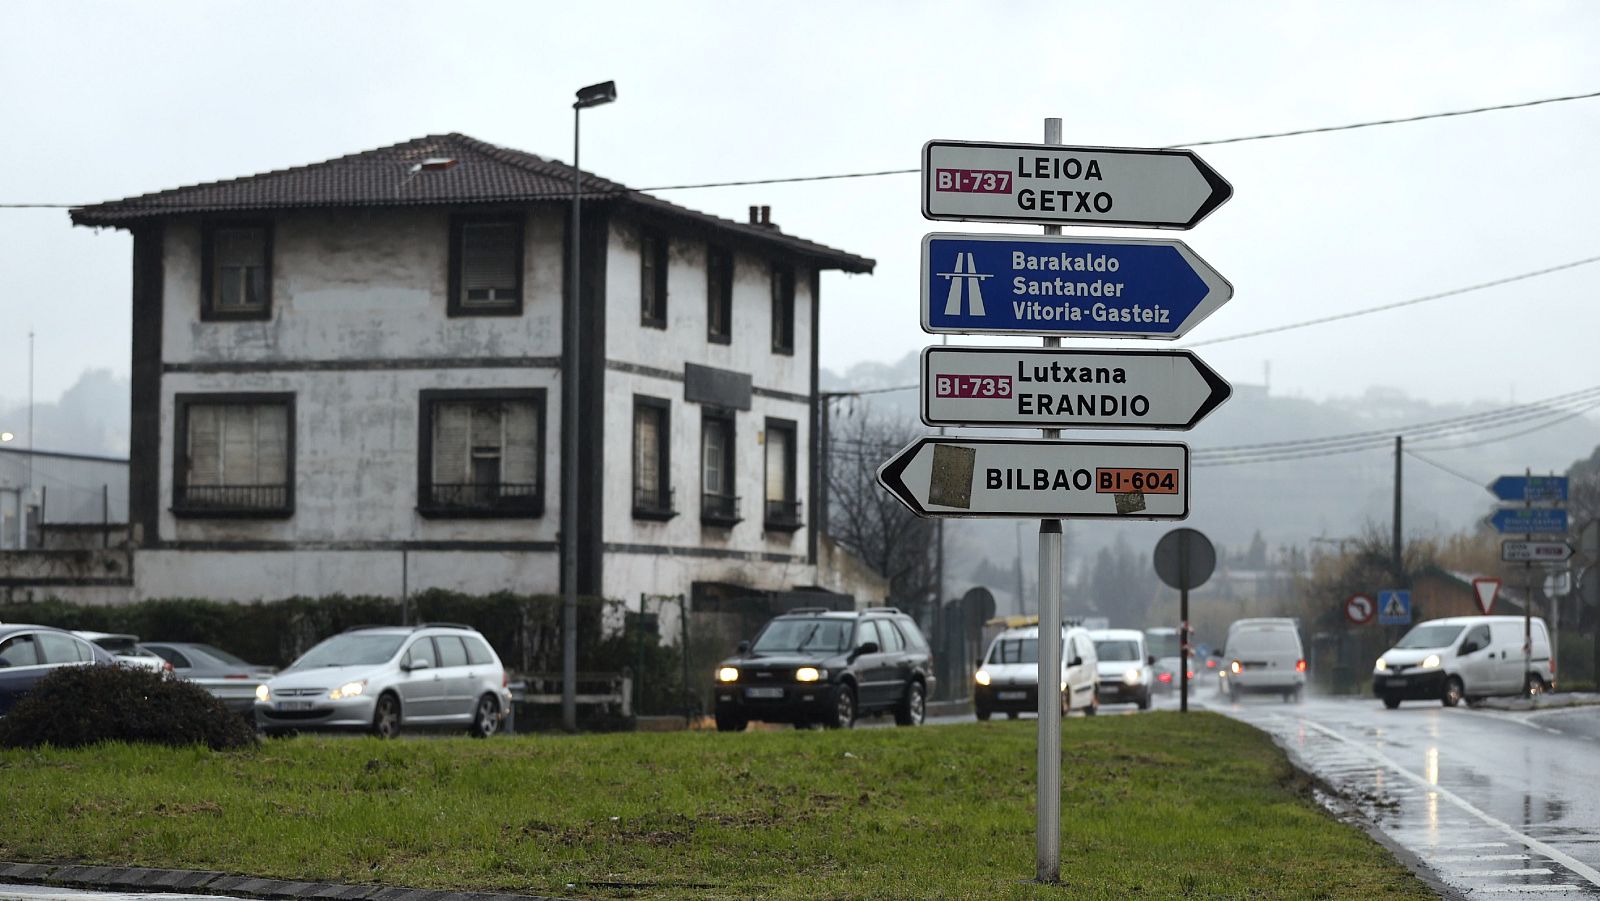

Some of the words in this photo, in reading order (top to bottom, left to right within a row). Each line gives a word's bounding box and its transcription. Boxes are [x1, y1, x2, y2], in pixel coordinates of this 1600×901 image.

[1019, 157, 1102, 180] LEIOA
[938, 172, 1010, 190] BI-737
[1018, 189, 1112, 213] GETXO
[1013, 252, 1119, 272] Barakaldo
[1013, 277, 1124, 296] Santander
[1013, 302, 1169, 322] Vitoria-Gasteiz
[1019, 361, 1126, 383] Lutxana
[938, 378, 1010, 396] BI-735
[1019, 394, 1149, 416] ERANDIO
[987, 469, 1091, 490] BILBAO
[1101, 472, 1174, 490] BI-604
